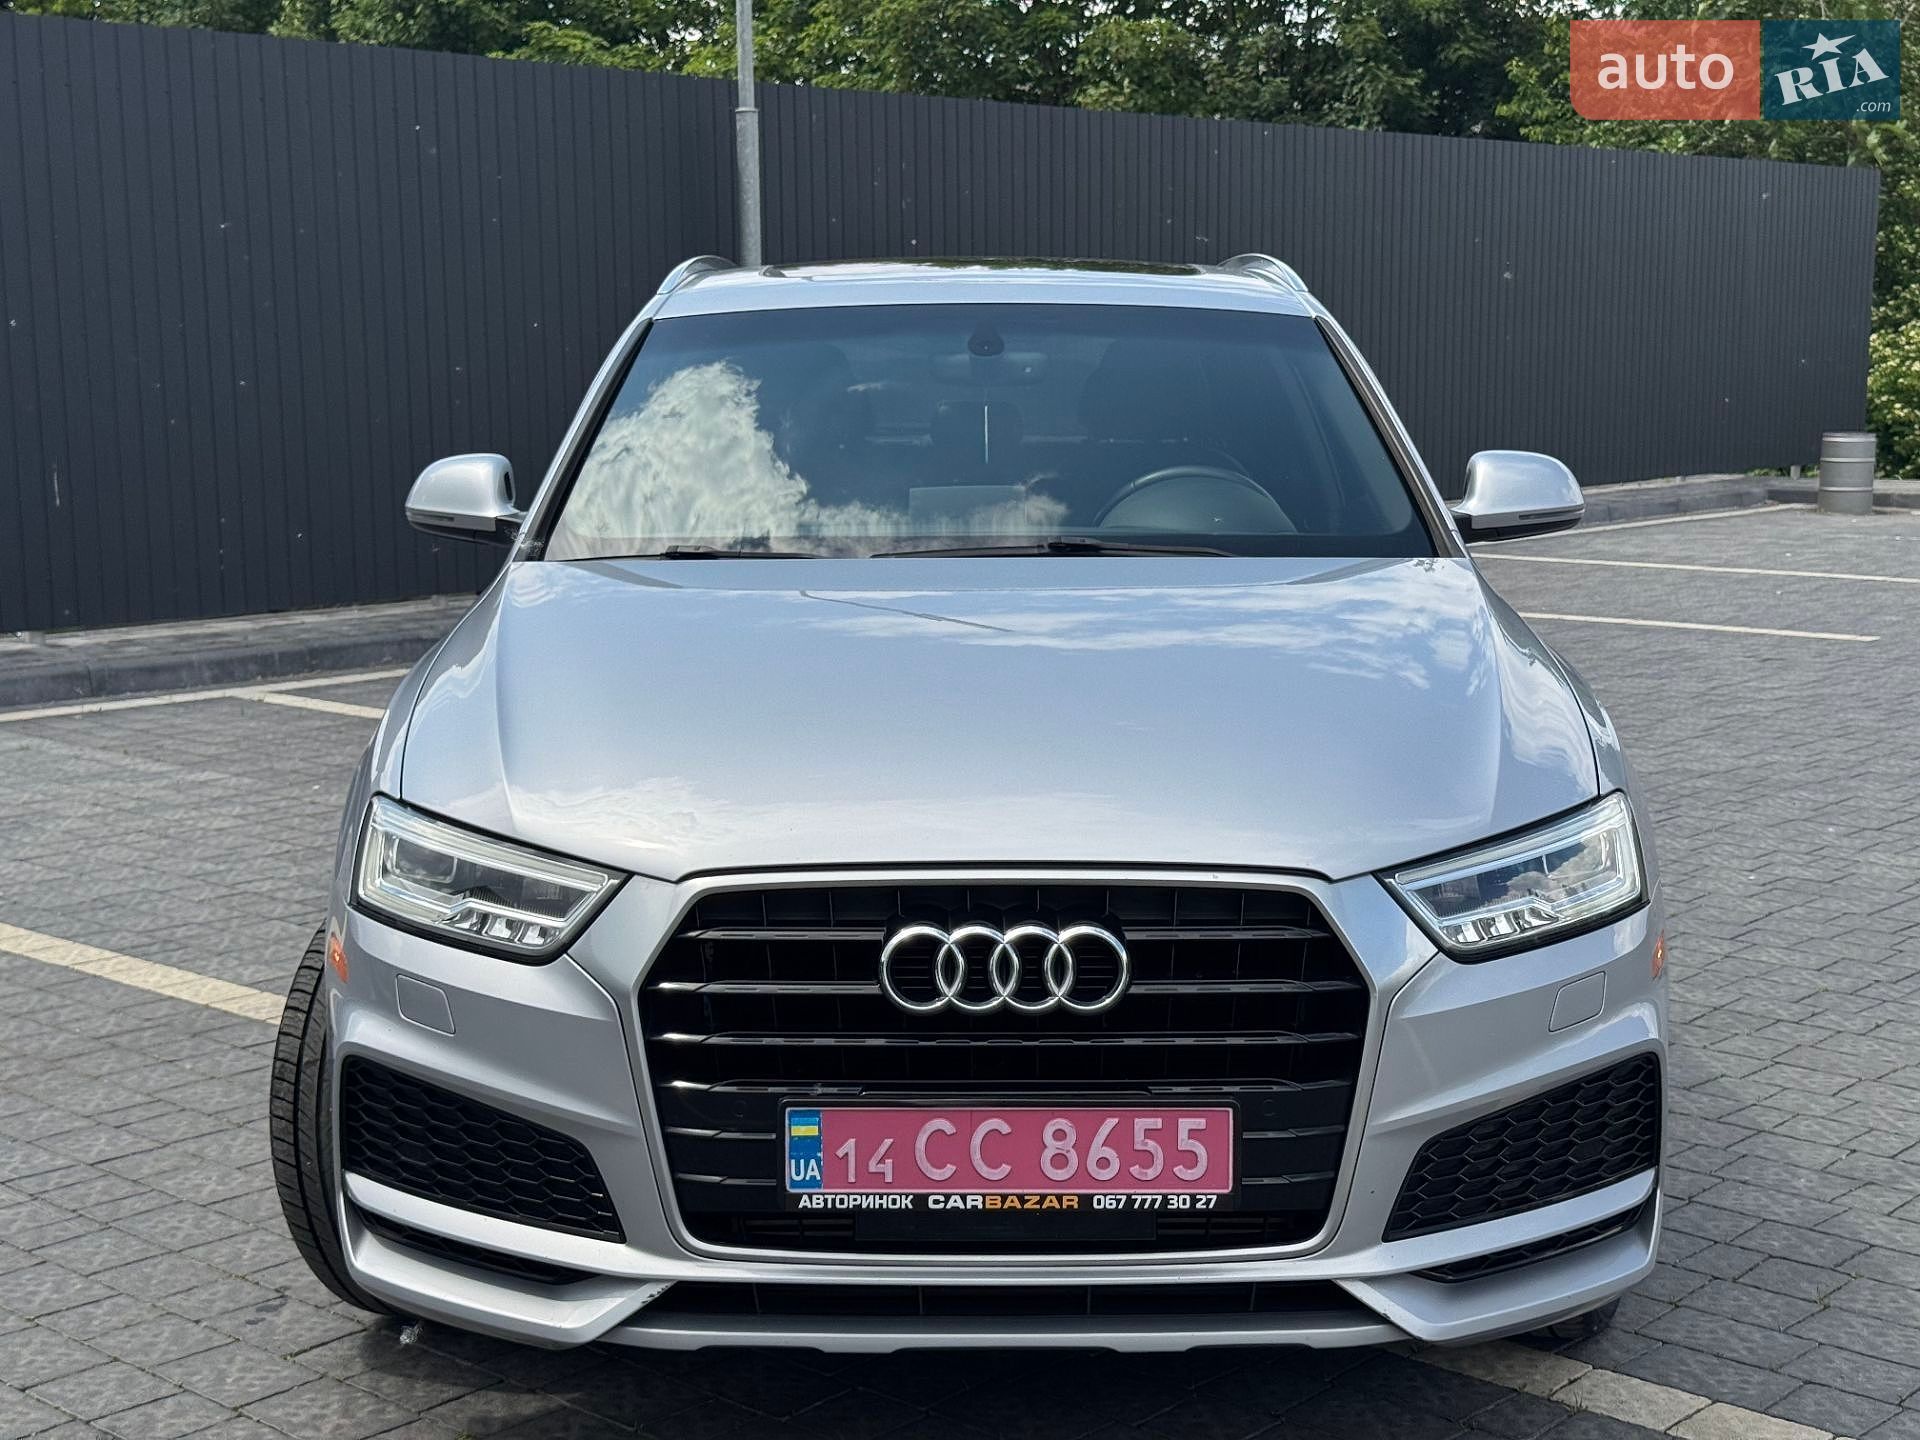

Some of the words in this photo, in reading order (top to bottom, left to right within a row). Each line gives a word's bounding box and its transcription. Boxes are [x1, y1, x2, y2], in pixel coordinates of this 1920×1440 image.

[834, 1138, 895, 1183] 14
[914, 1118, 1012, 1181] CC
[1040, 1118, 1208, 1181] 8655
[790, 1159, 820, 1181] UA
[798, 1194, 913, 1210] АВТОРИНОК
[928, 1195, 1079, 1210] CARBAZAR
[1093, 1195, 1127, 1210] 067
[1131, 1195, 1163, 1210] 777
[1167, 1195, 1190, 1210] 30
[1195, 1195, 1217, 1210] 27
